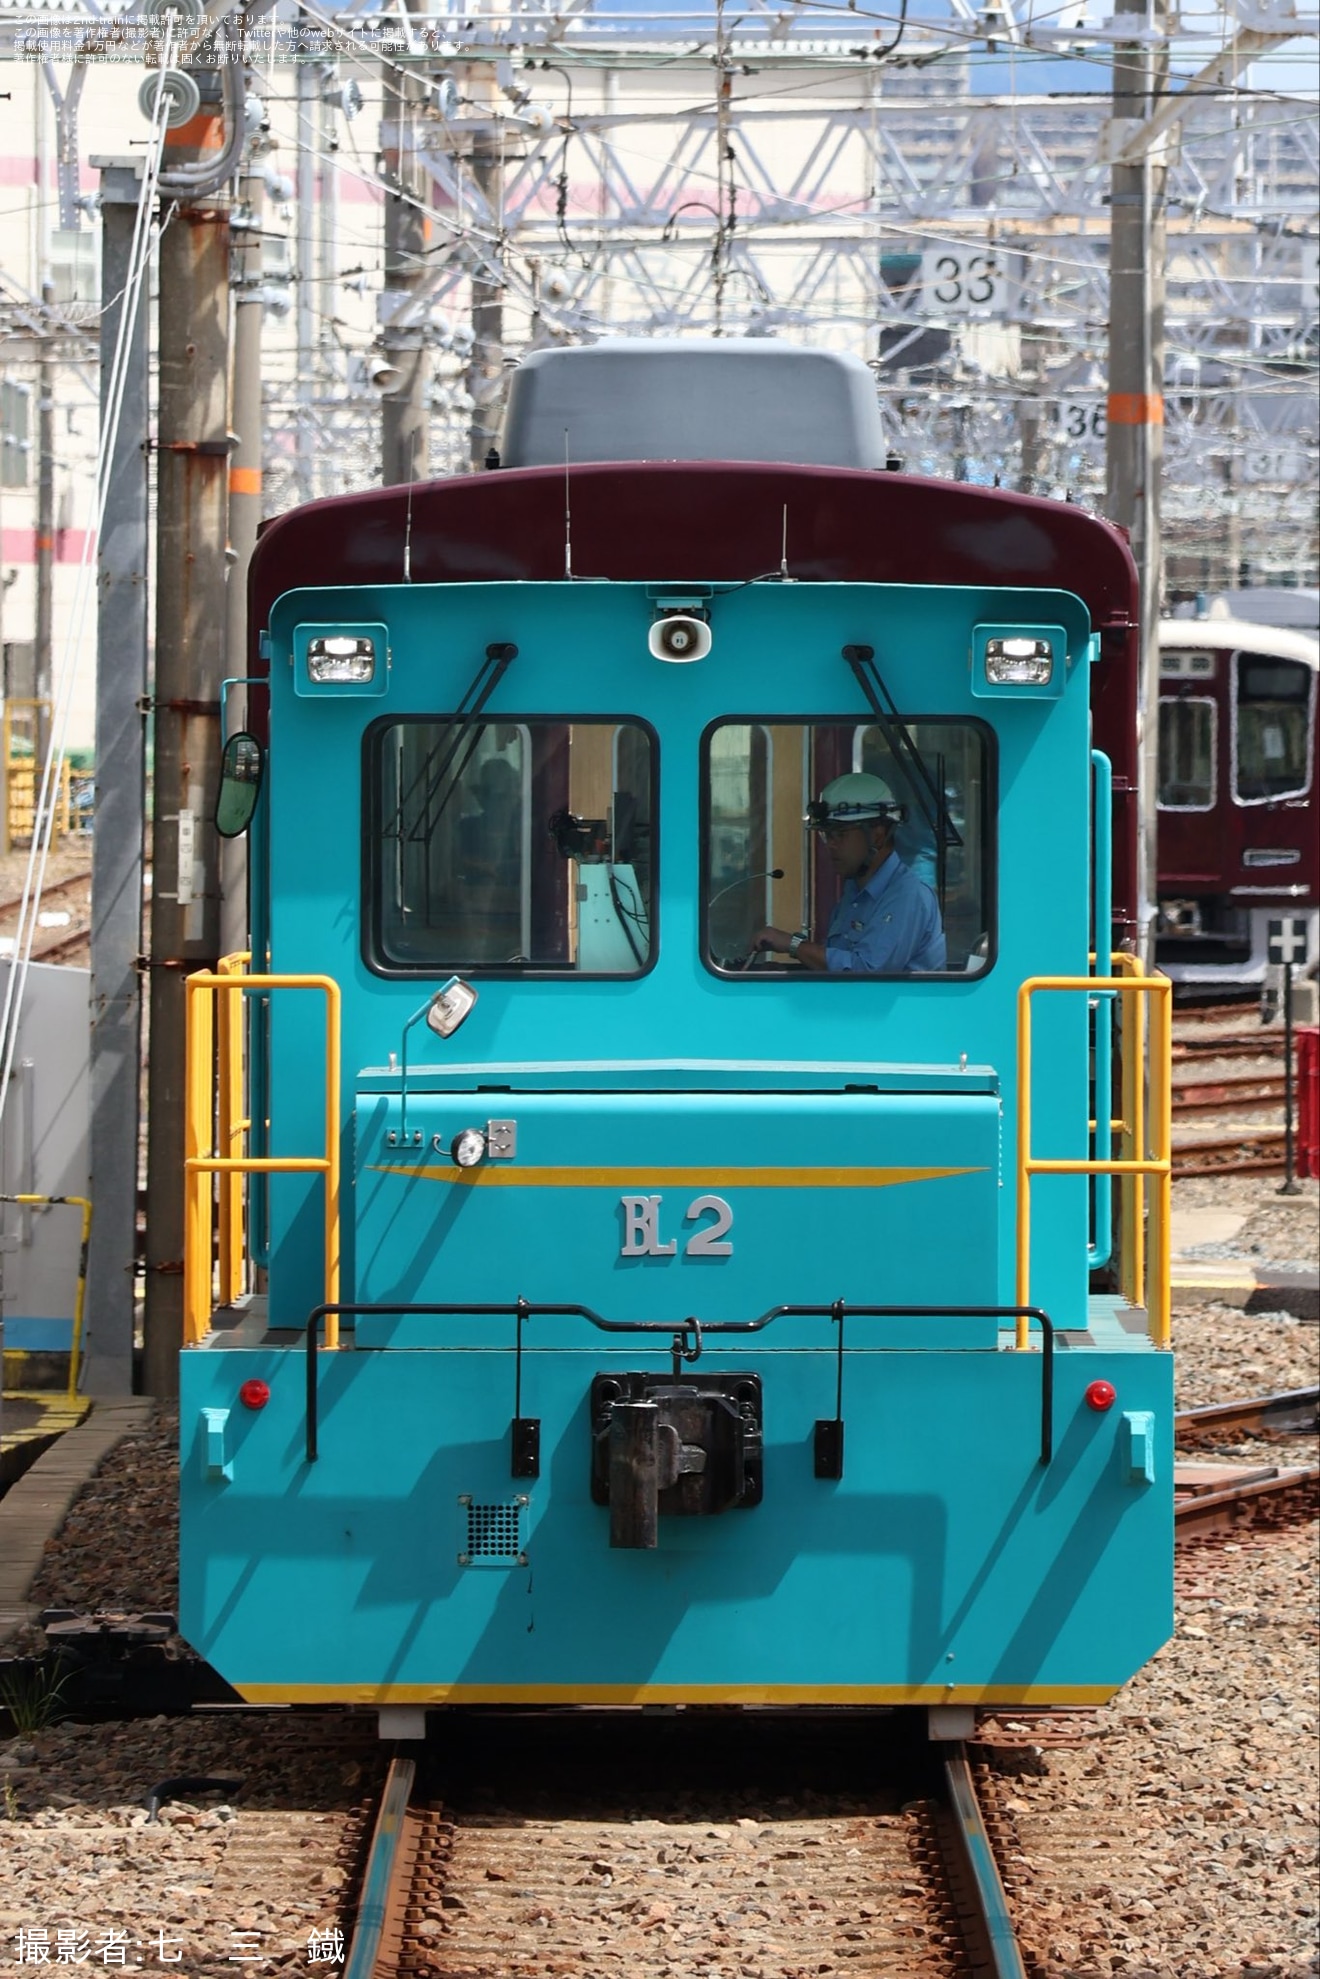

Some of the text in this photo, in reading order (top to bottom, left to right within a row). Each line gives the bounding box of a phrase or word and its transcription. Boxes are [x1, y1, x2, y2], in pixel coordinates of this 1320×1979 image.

[935, 257, 994, 303] 33
[621, 1195, 733, 1256] BL 2
